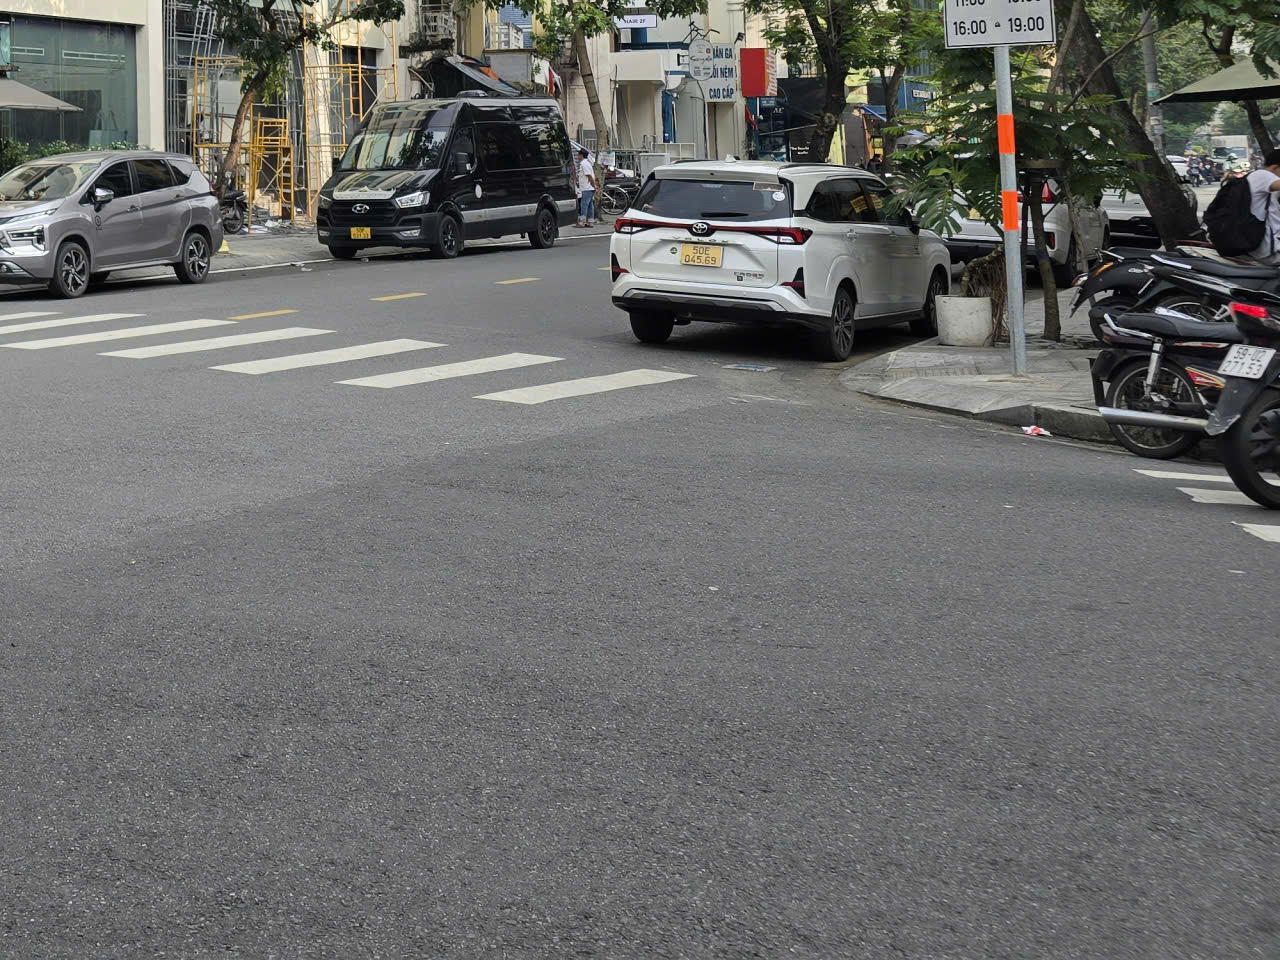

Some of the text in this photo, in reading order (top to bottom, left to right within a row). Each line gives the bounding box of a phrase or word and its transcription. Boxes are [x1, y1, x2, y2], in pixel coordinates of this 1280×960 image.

[953, 19, 987, 36] 16:00
[1008, 16, 1045, 33] 19:00
[724, 47, 733, 59] GA
[708, 84, 734, 99] CAO CẤP
[692, 245, 711, 256] 50E
[684, 254, 717, 265] 045.69
